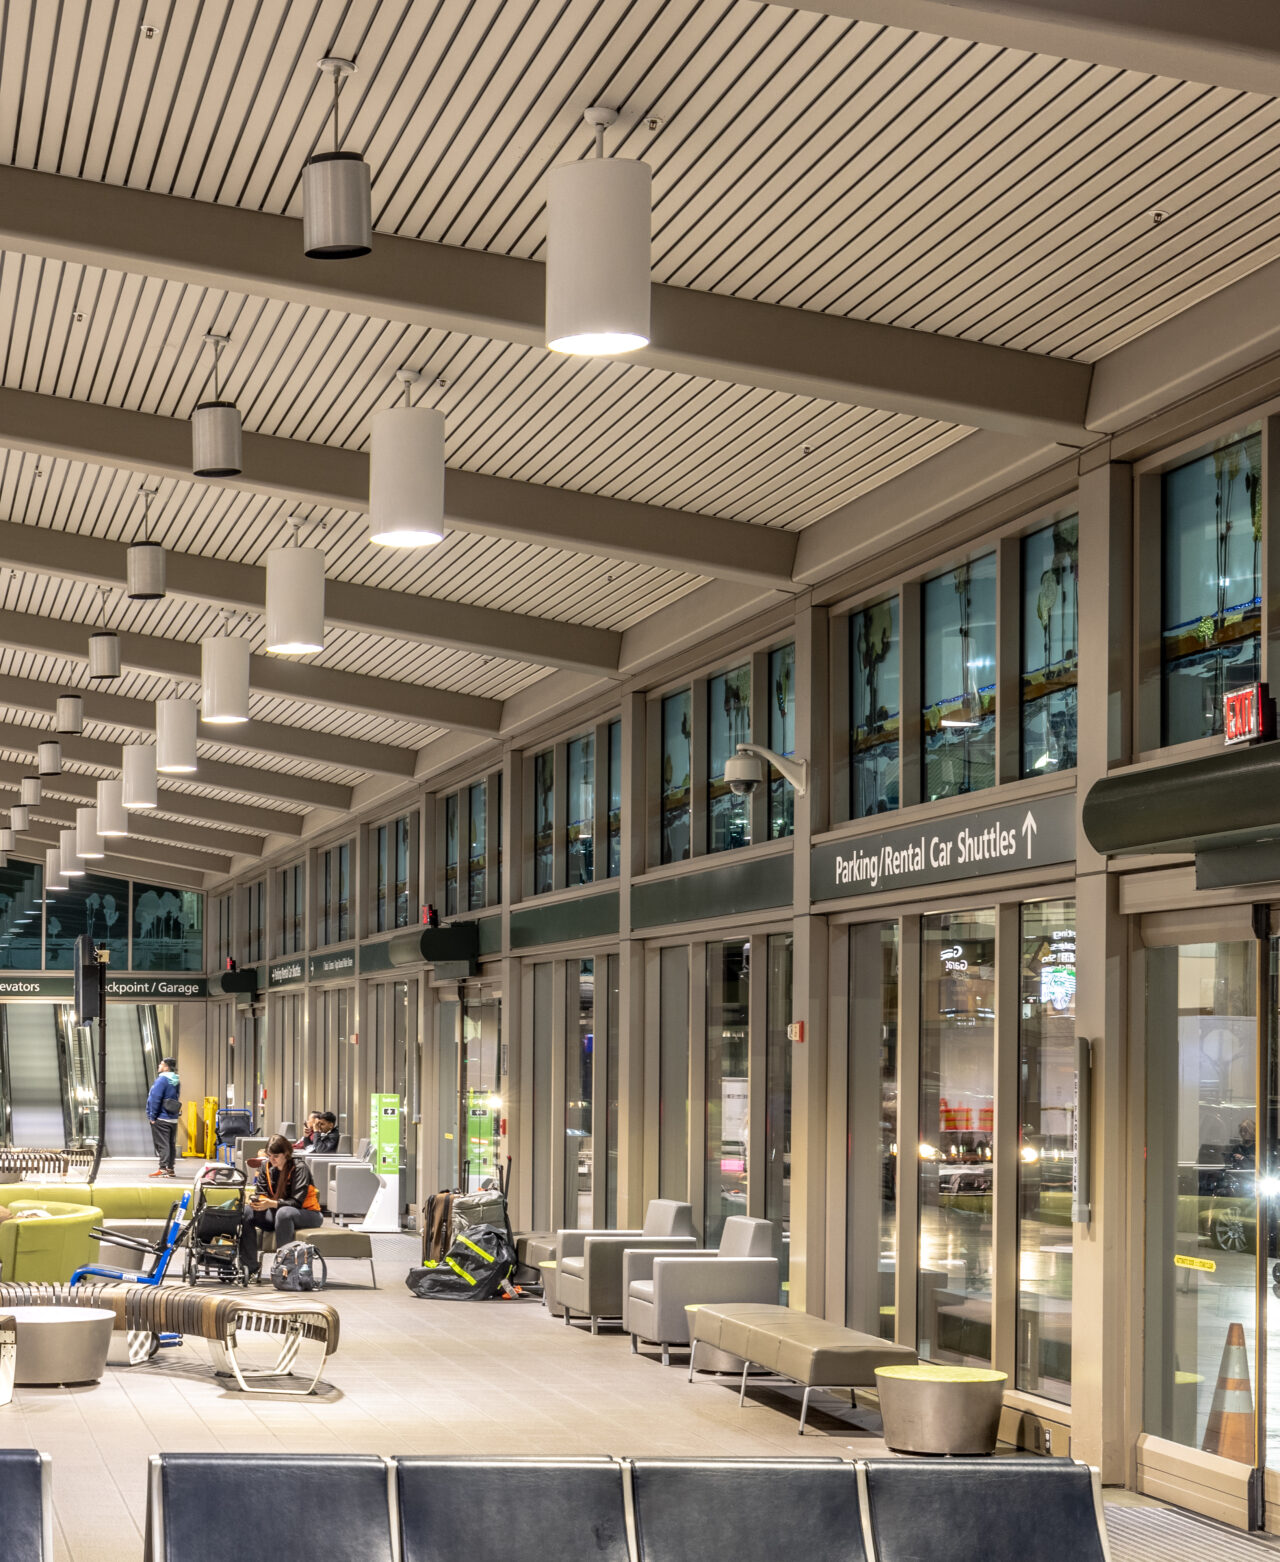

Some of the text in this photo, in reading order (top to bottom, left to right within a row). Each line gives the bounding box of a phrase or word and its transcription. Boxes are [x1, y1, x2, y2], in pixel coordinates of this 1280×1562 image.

[1226, 690, 1253, 740] EXIT
[835, 822, 1017, 887] Parking/Rental Car Shuttles
[158, 982, 200, 995] Garage
